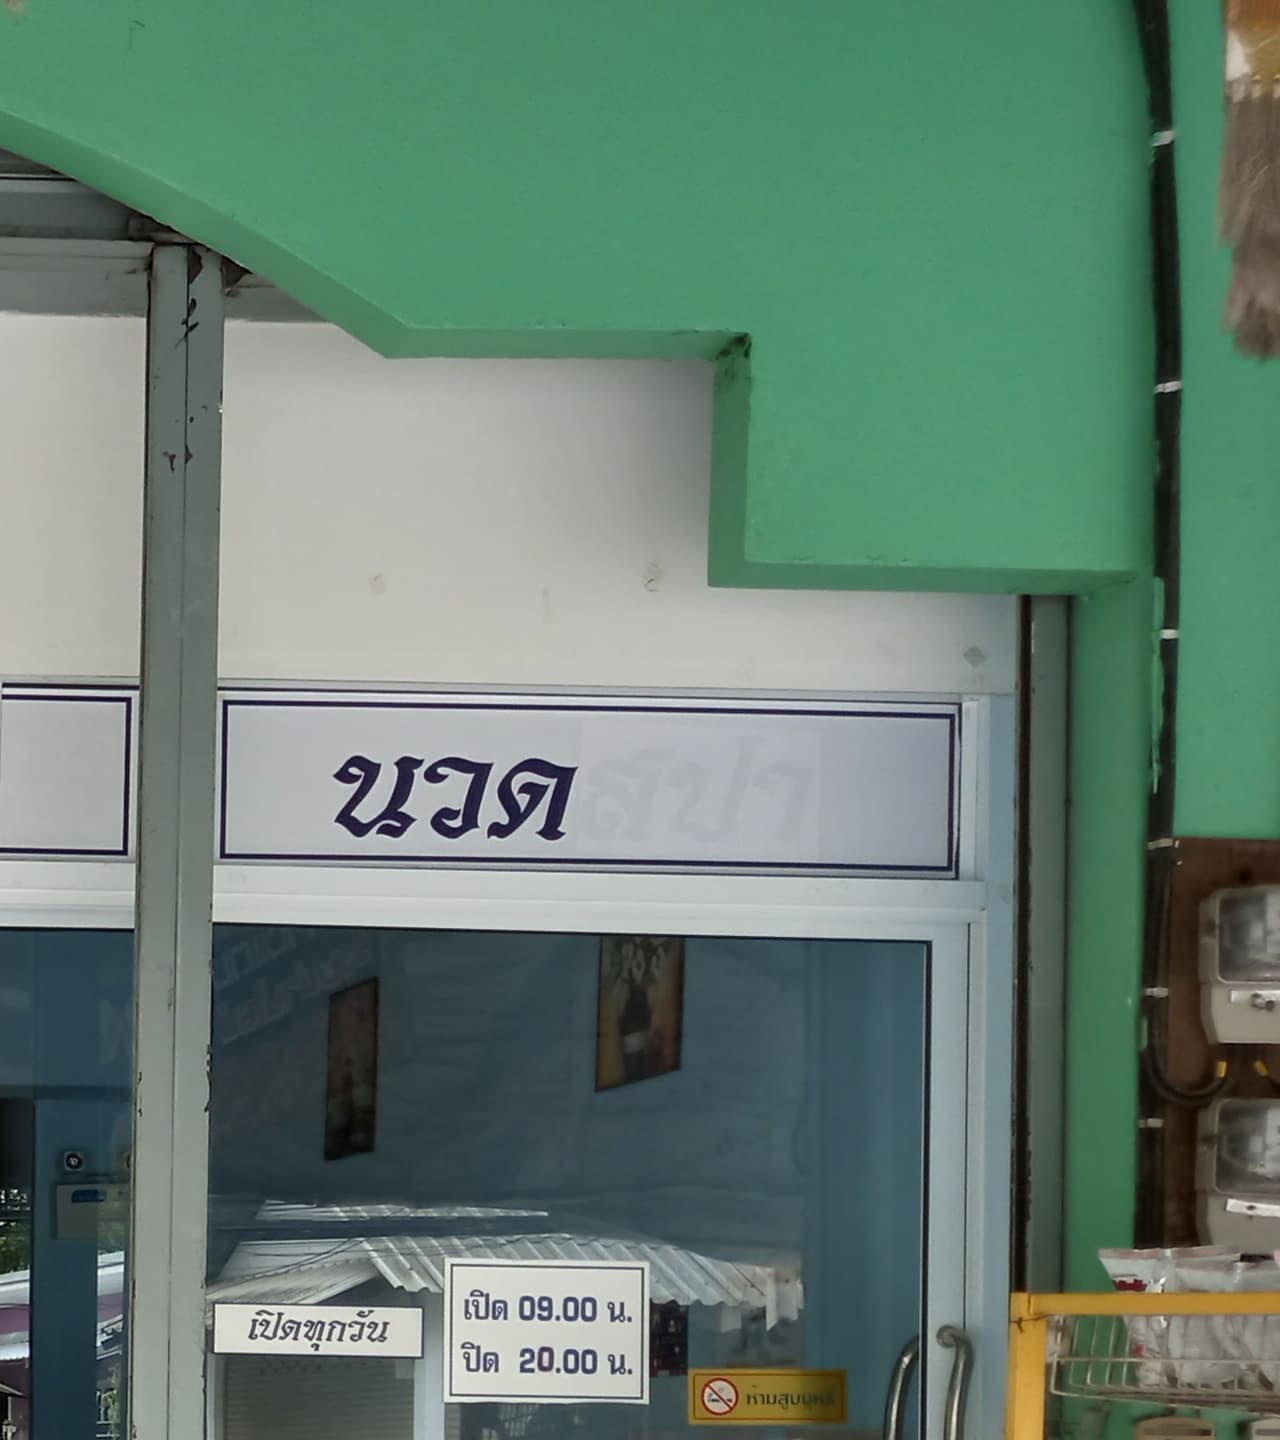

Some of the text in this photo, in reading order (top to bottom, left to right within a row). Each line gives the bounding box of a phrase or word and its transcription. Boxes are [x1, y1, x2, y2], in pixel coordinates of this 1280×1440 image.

[333, 755, 578, 840] นวด
[464, 1290, 632, 1323] เปิด 09.00 น.
[247, 1310, 389, 1351] เปิดทุกวัน
[461, 1342, 632, 1375] ปิด 20.00 น.
